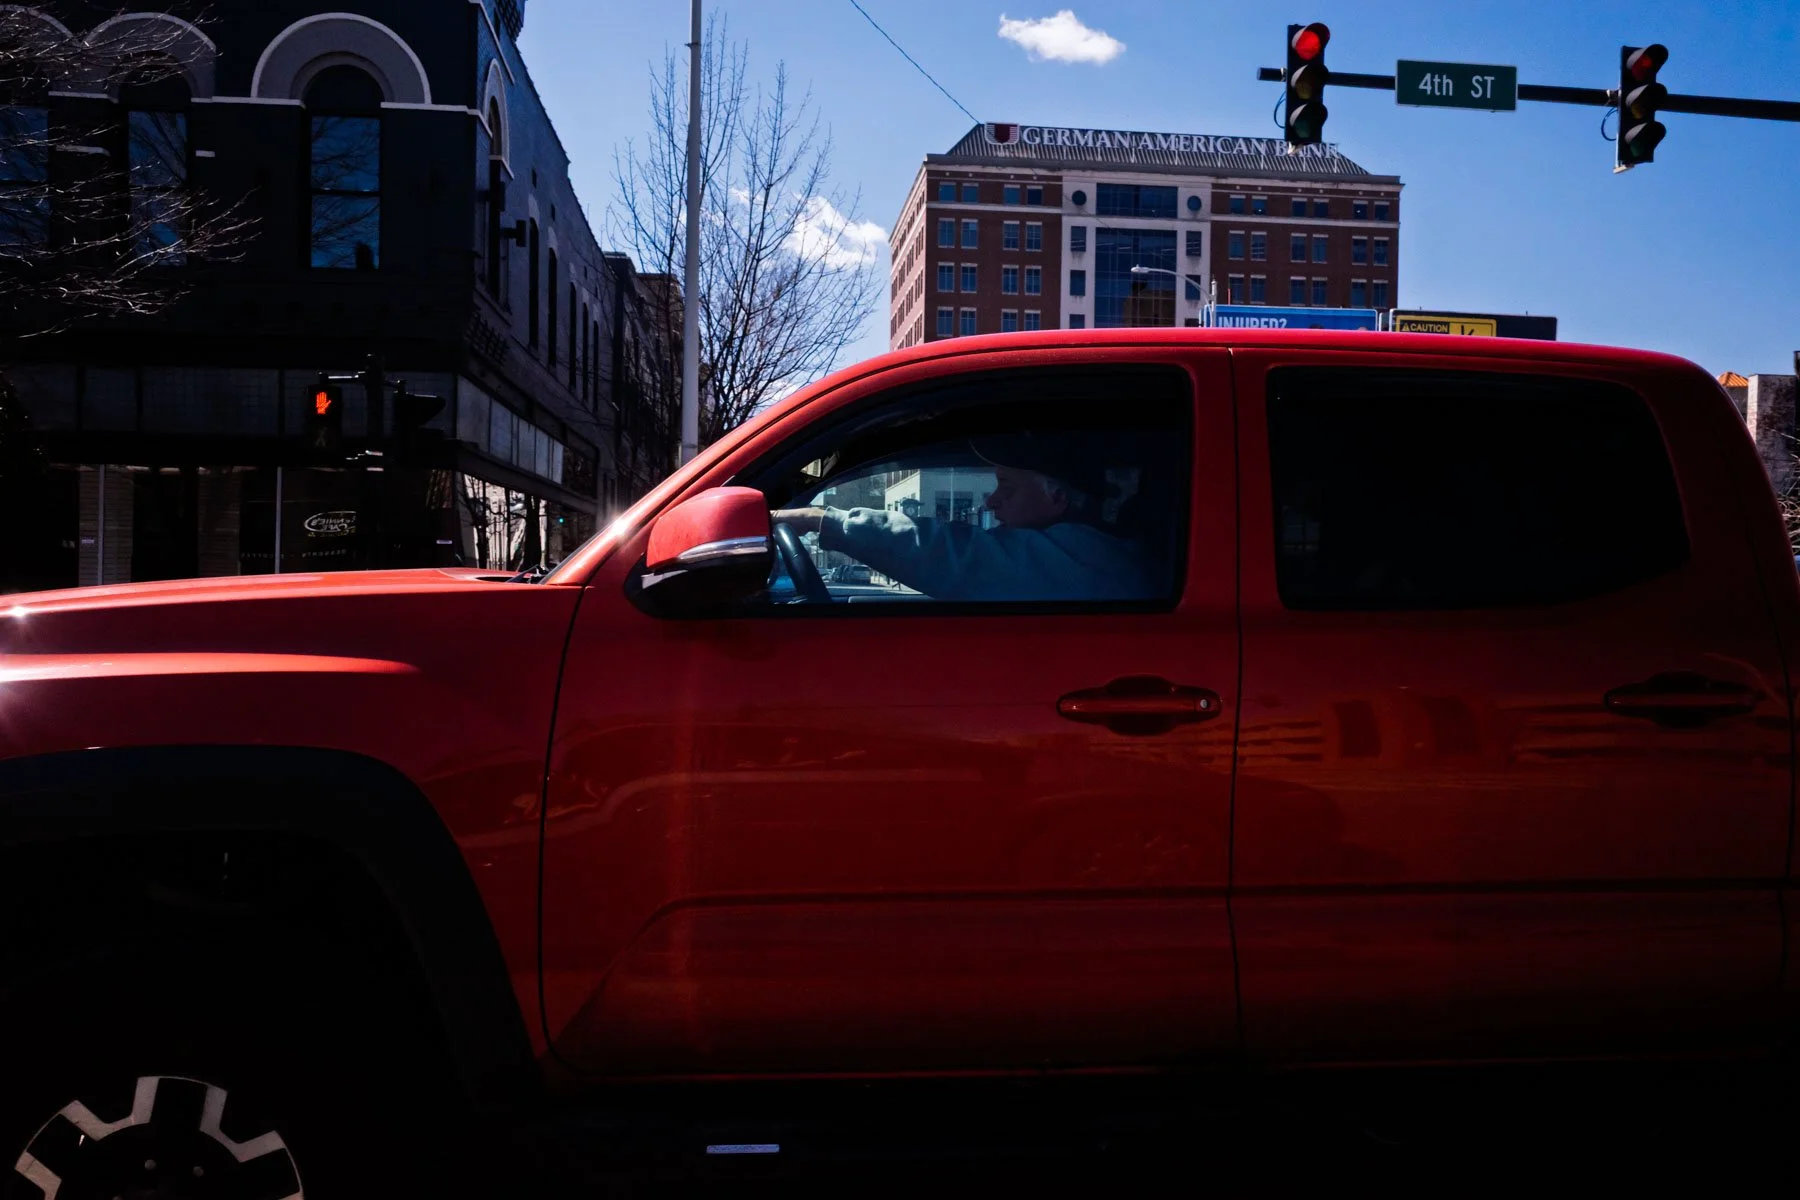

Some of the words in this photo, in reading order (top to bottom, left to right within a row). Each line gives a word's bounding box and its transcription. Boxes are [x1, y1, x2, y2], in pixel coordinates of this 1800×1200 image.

[1418, 72, 1453, 96] 4th
[1470, 75, 1495, 99] ST
[1023, 126, 1131, 149] GERMAN
[1138, 132, 1268, 156] AMERICAN
[1410, 322, 1448, 333] CAUTION
